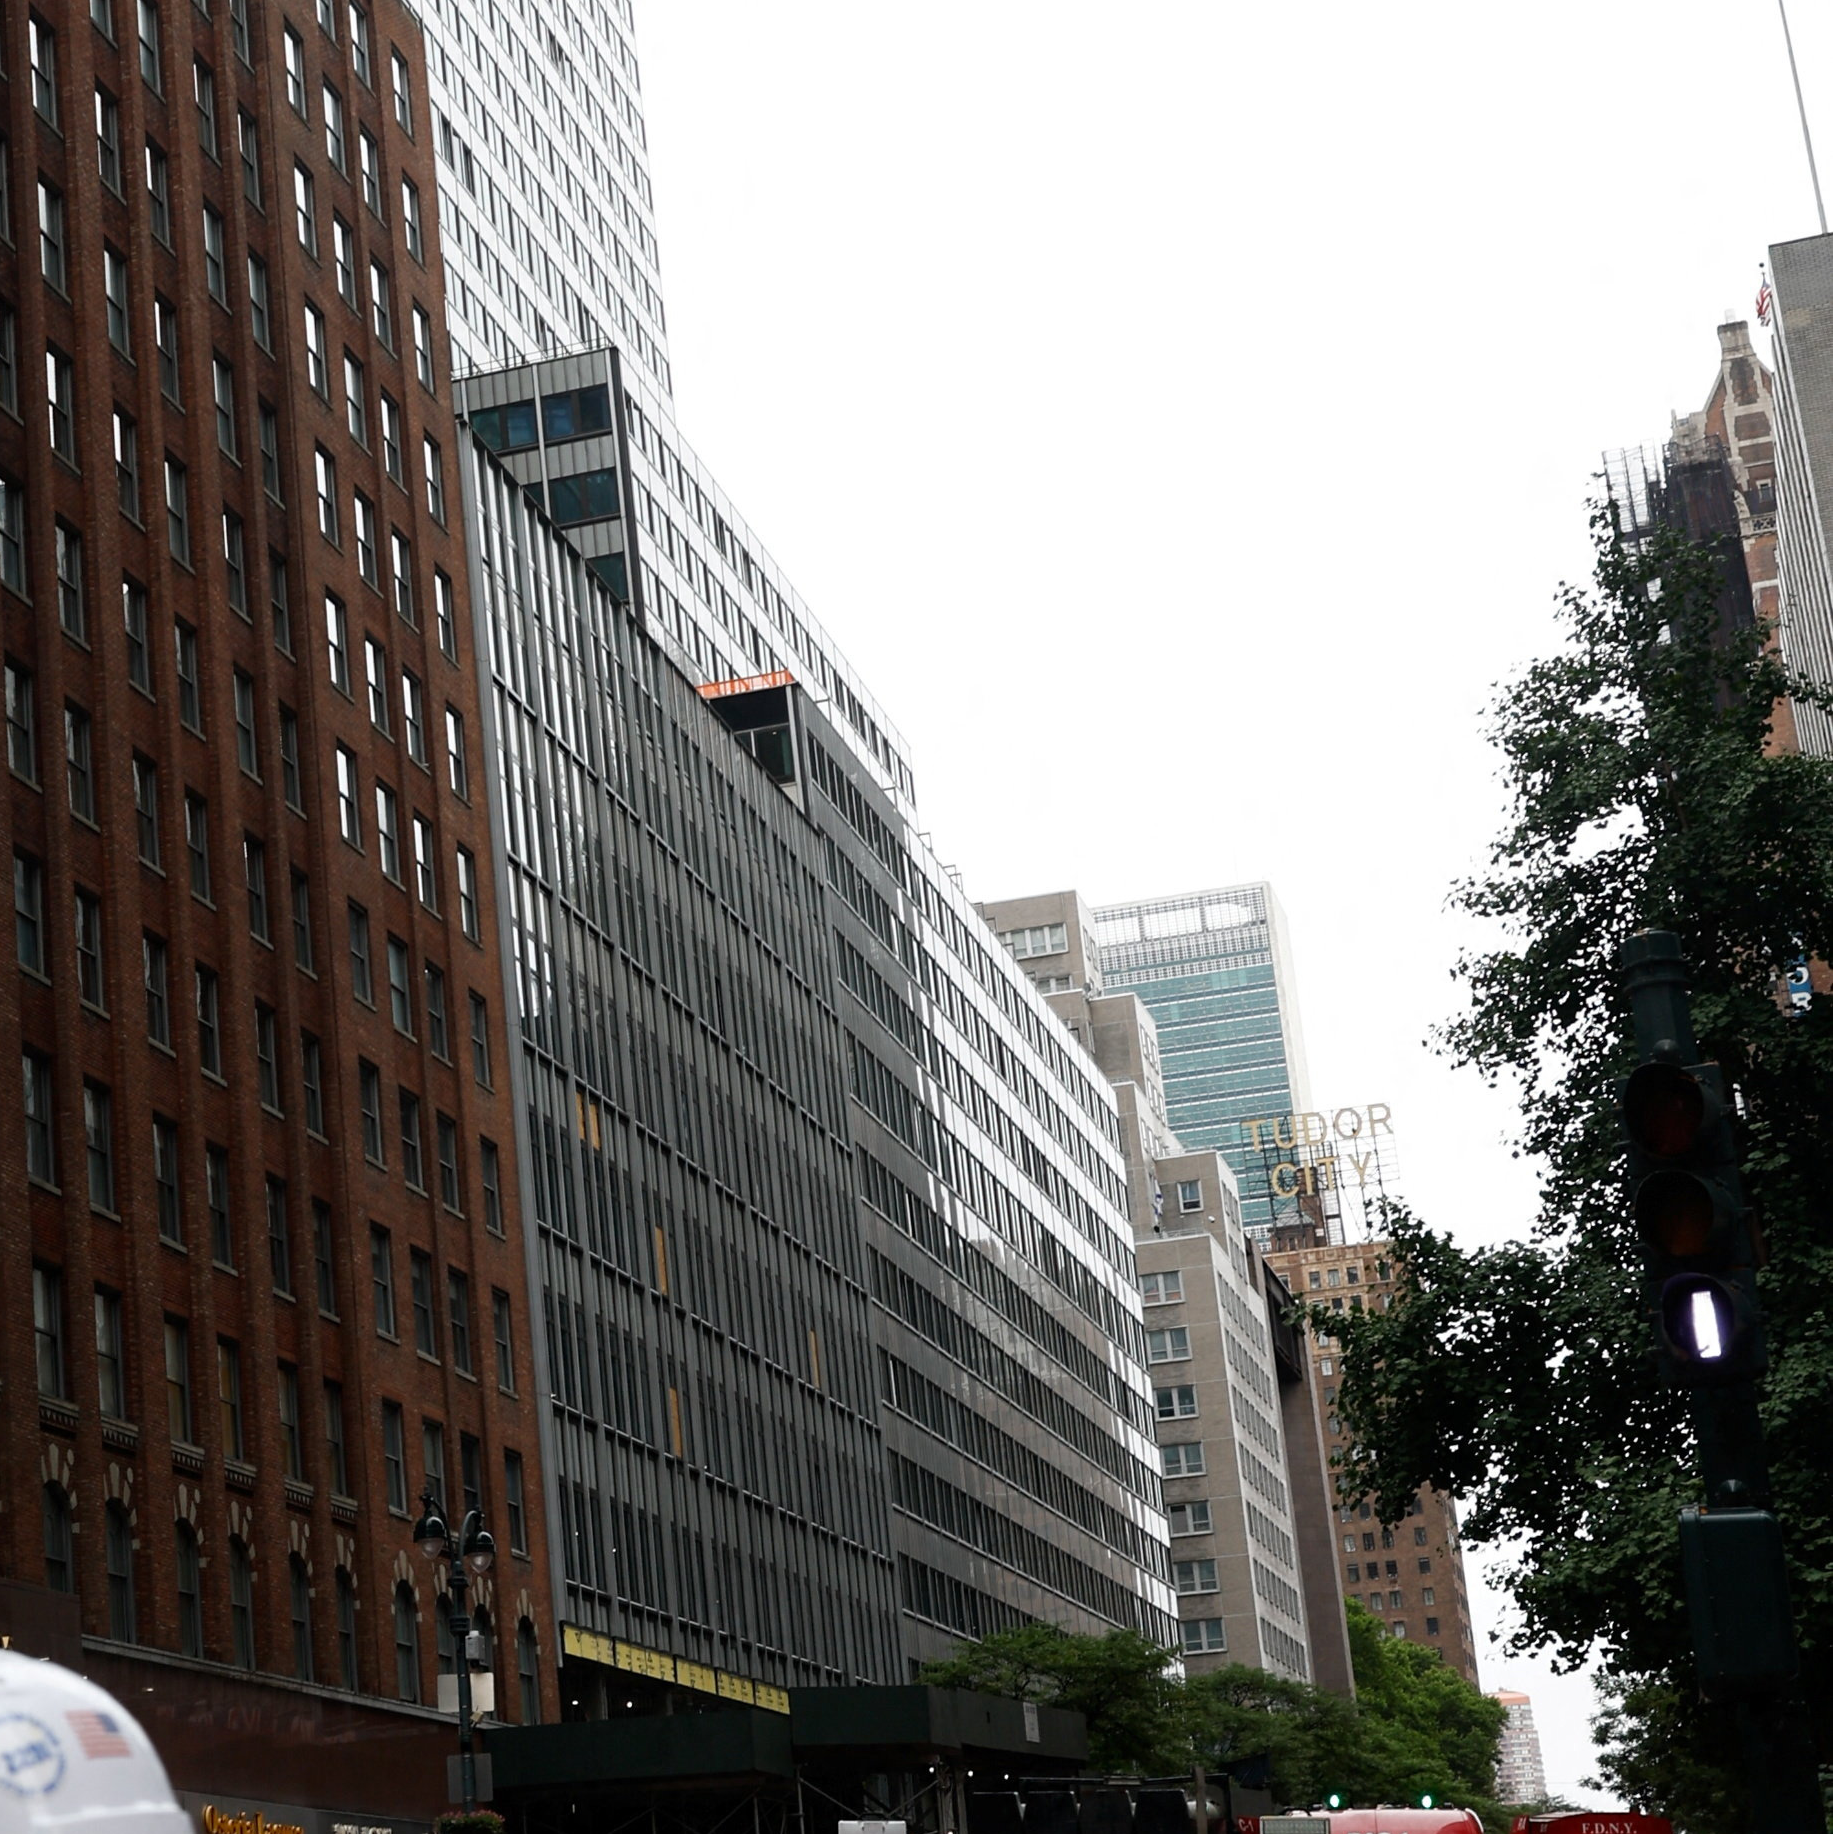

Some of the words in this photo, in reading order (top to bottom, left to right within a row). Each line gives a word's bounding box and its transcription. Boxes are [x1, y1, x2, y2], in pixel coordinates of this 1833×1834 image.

[1241, 1103, 1394, 1153] TUDOR
[1271, 1152, 1372, 1198] CITY
[1238, 1818, 1255, 1833] C-1
[1582, 1823, 1637, 1834] F.D.N.Y.
